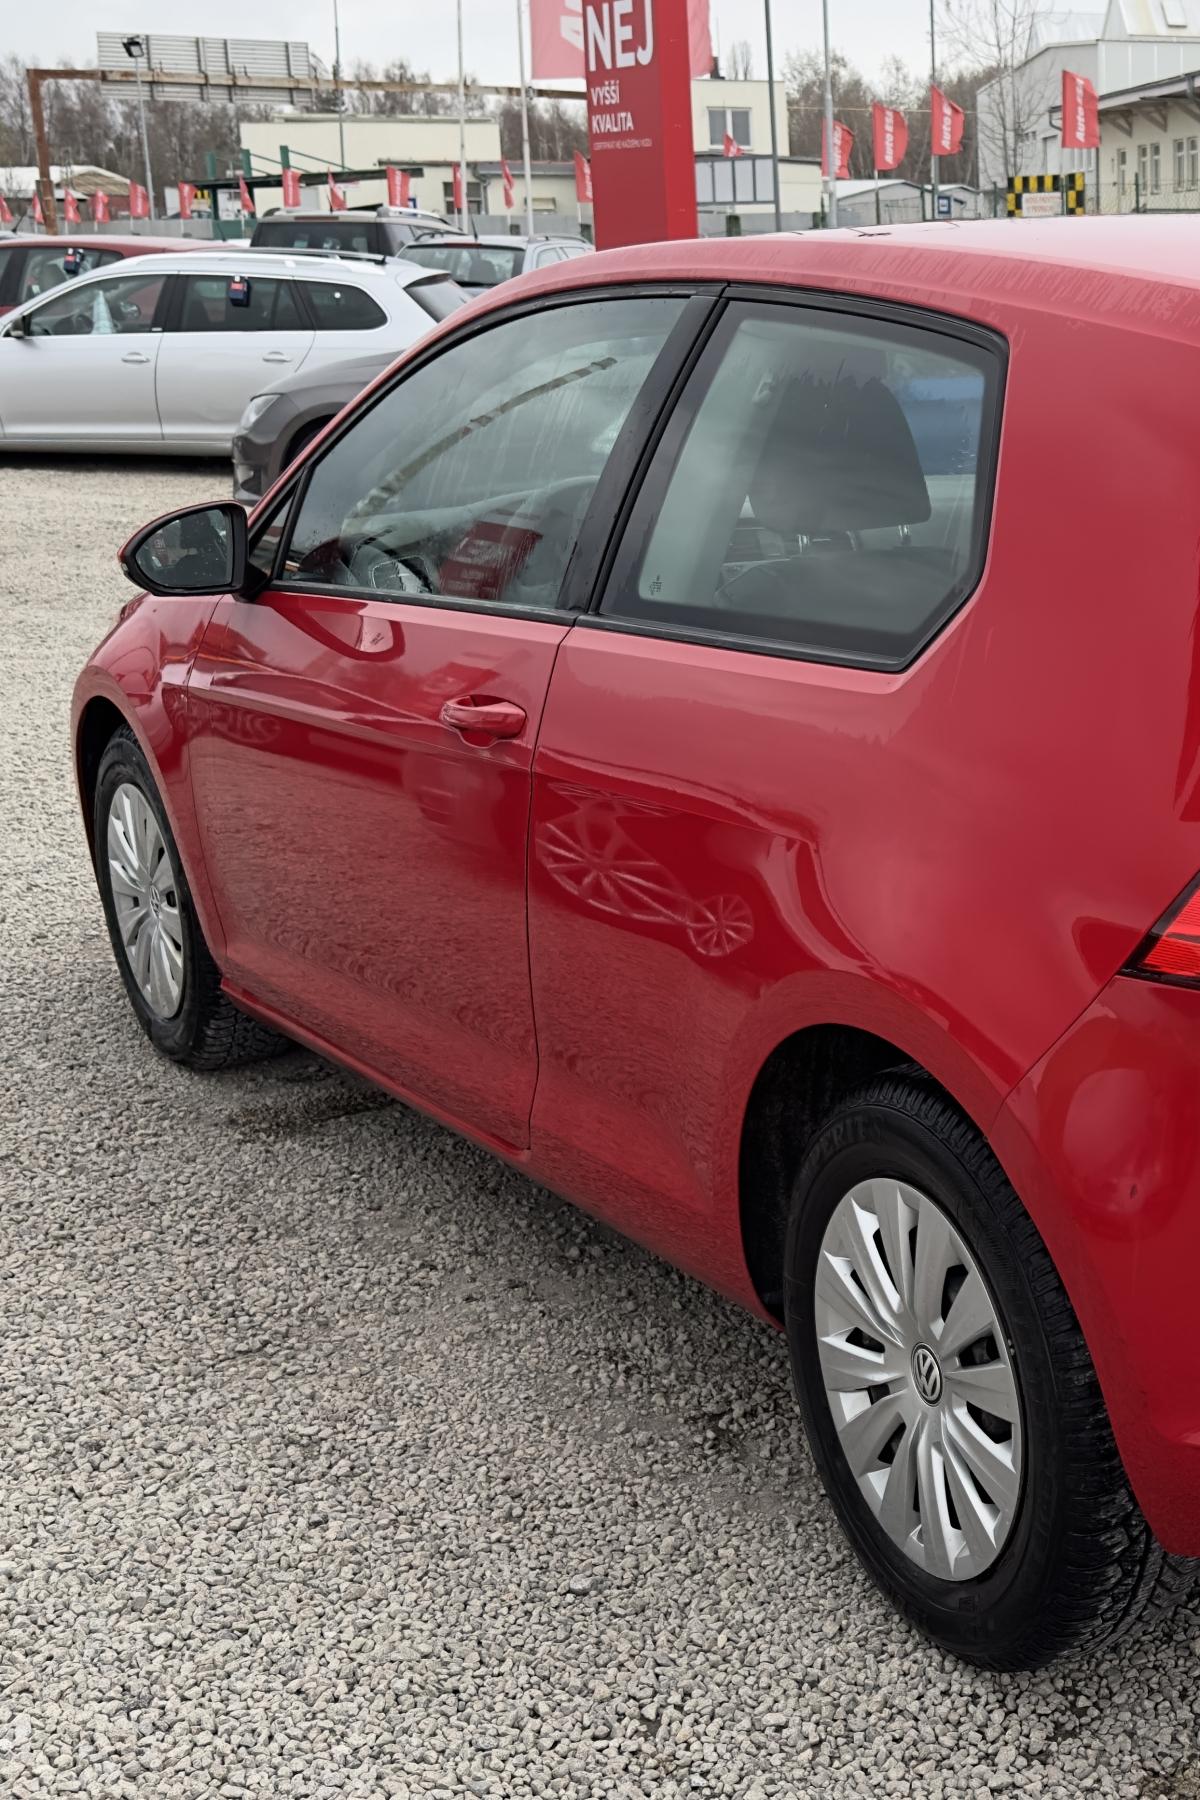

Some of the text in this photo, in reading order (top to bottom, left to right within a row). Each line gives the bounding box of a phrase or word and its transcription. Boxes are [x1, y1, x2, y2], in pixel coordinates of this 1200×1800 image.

[586, 0, 654, 72] NEJ
[591, 80, 620, 106] VYŠŠÍ
[592, 111, 634, 134] KVALITA
